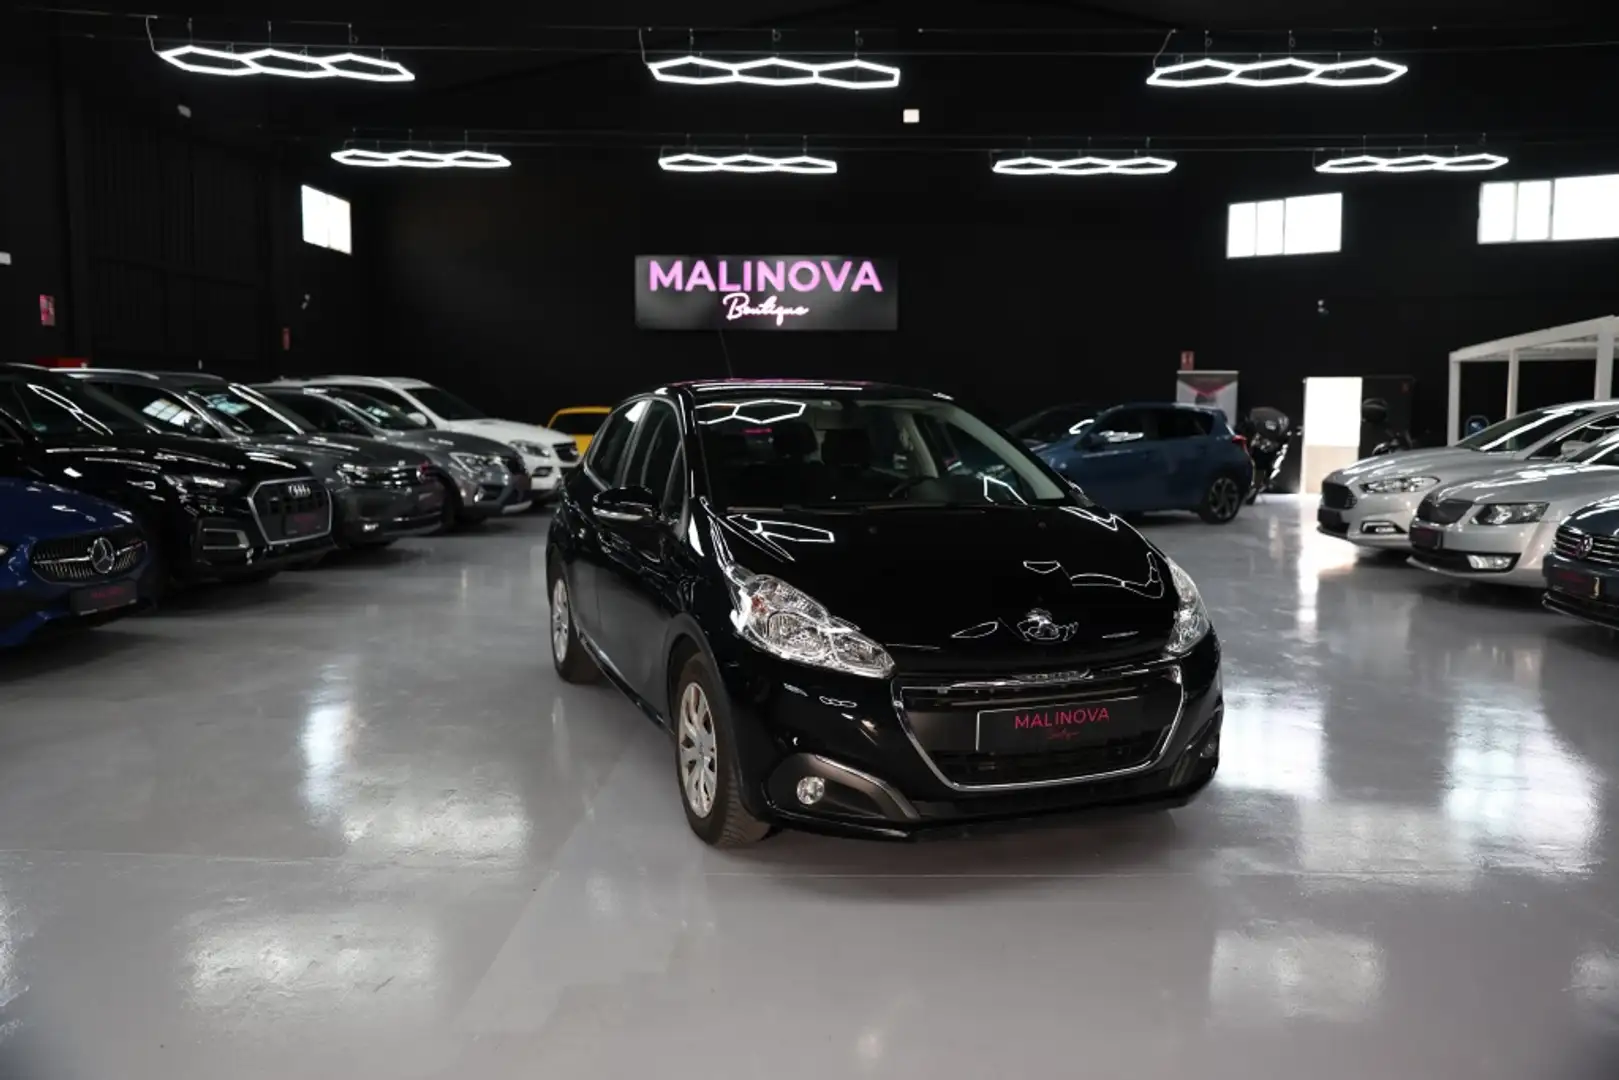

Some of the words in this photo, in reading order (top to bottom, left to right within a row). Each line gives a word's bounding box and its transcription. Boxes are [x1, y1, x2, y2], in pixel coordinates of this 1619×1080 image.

[649, 260, 883, 292] MALINOVA
[722, 292, 809, 326] Boutique
[1014, 707, 1110, 729] MALINOVA
